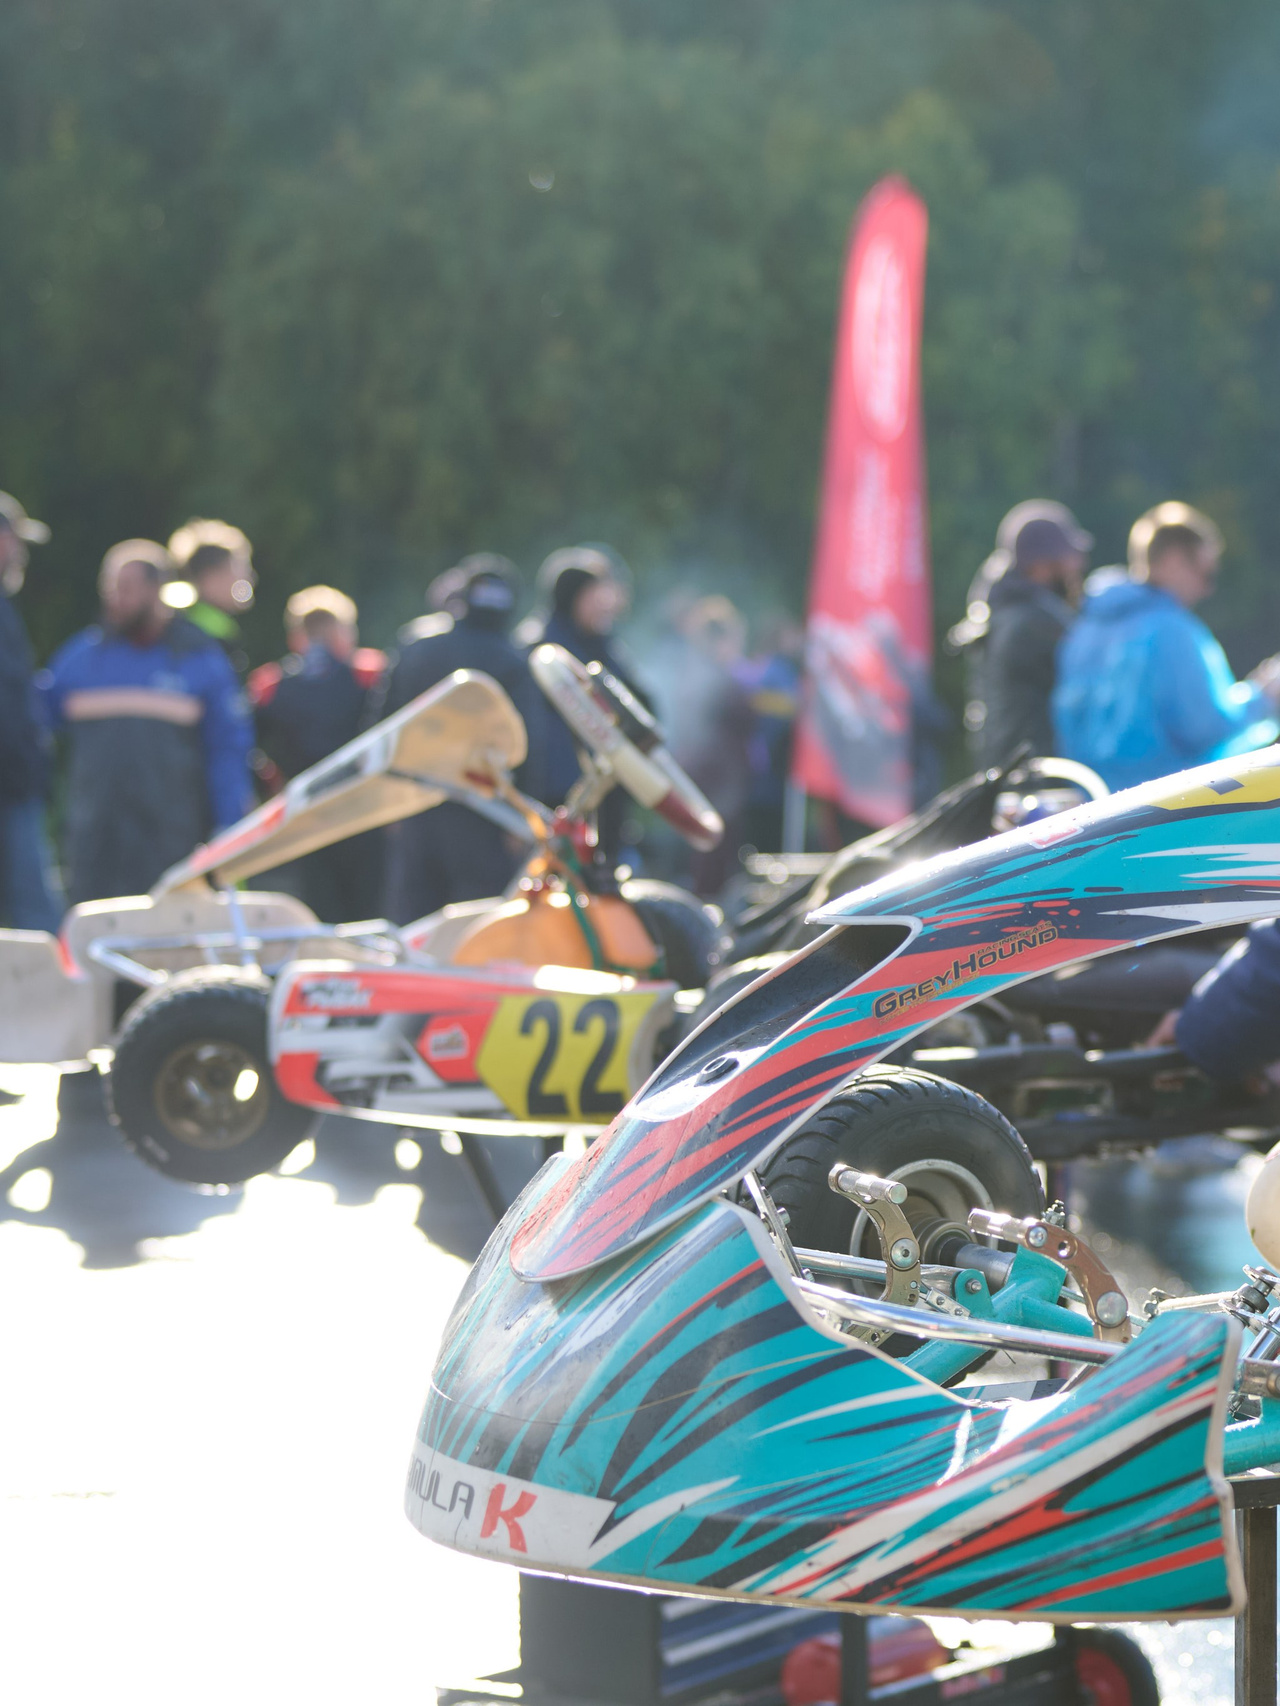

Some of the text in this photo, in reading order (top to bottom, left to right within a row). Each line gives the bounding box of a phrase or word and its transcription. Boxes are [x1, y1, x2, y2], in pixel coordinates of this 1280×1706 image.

[977, 920, 1052, 955] RACING SEATS
[520, 997, 624, 1116] 22
[408, 1456, 538, 1554] MULA K
